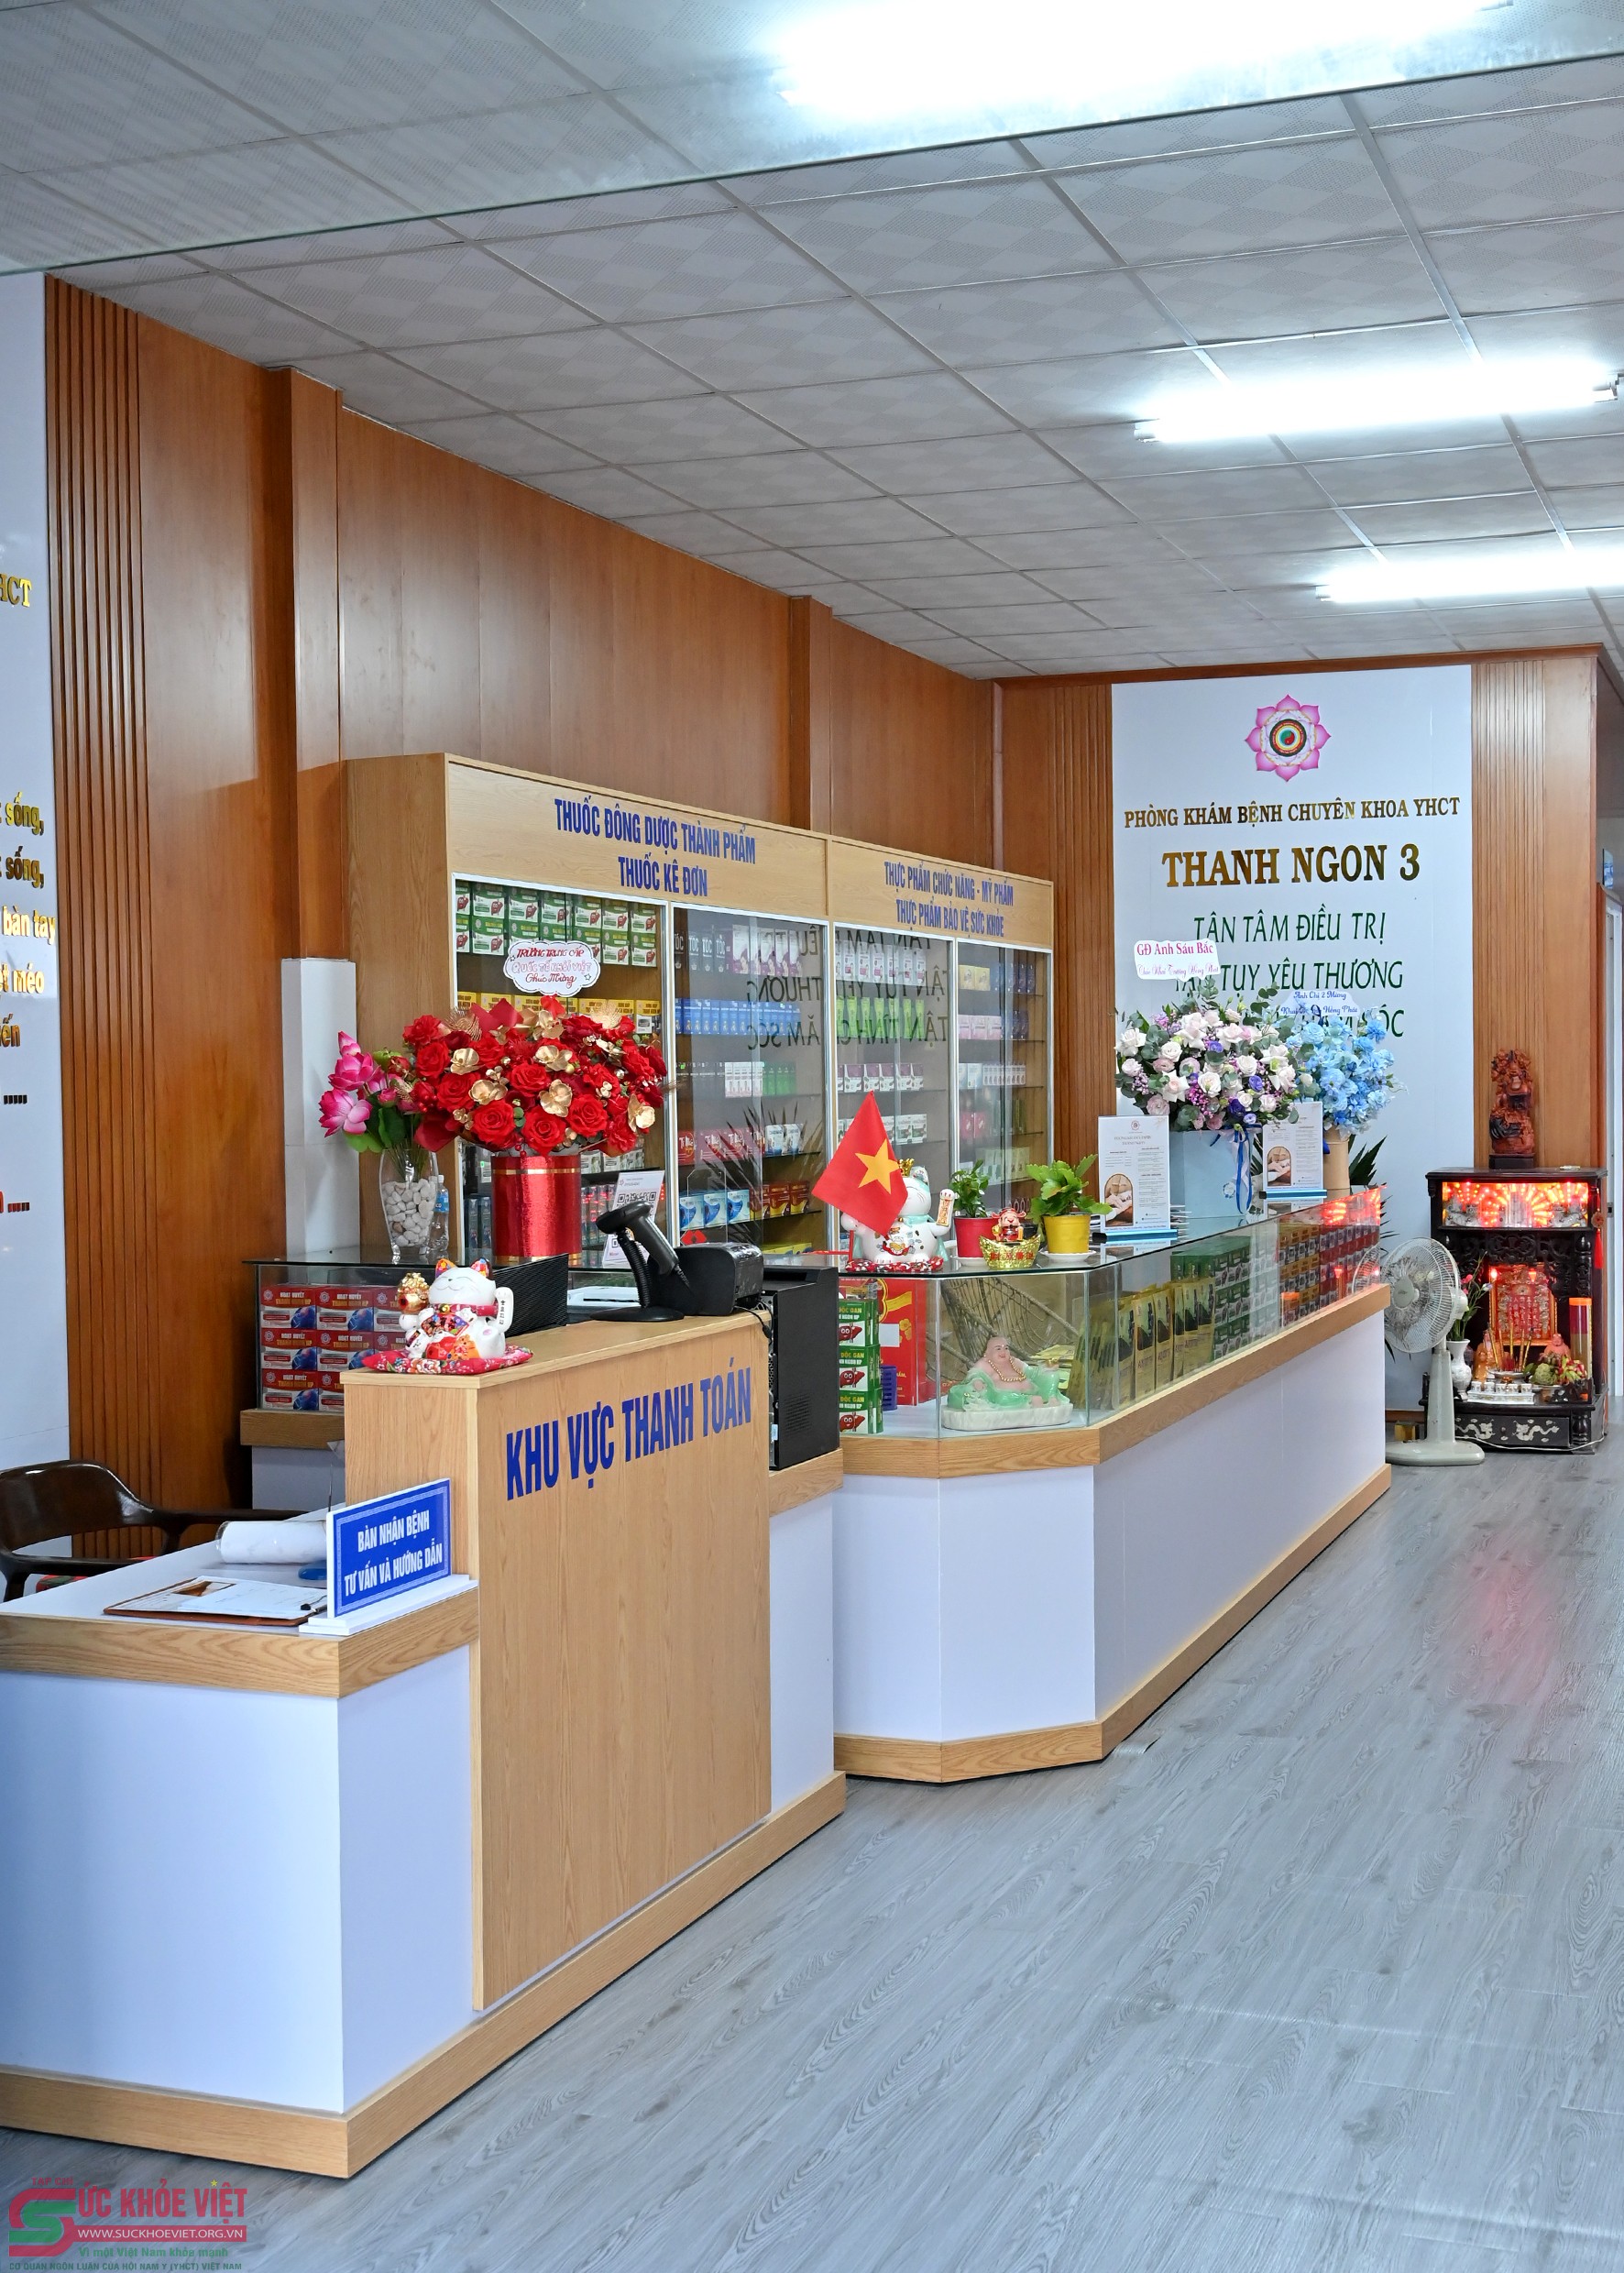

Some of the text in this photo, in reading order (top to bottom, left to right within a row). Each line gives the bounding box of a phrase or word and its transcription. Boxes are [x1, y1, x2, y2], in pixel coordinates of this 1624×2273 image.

[5, 791, 44, 836] sống,
[554, 795, 756, 864] THUỐC ĐÔNG DƯỢC THÀNH PHẨM
[1125, 796, 1460, 828] PHÒNG KHÁM BỆNH CHUYÊN KHOA YHCT
[5, 845, 44, 889] sống,
[618, 852, 708, 896] THUỐC KÊ ĐƠN
[883, 861, 905, 893] THỰC
[907, 861, 931, 893] PHẨM
[933, 869, 953, 896] CHỨC
[955, 873, 975, 900] NĂNG
[982, 877, 993, 903] MỸ
[994, 877, 1014, 906] PHẨM
[1162, 843, 1421, 887] THANH NGON 3
[3, 906, 56, 945] bàn tay
[895, 895, 1004, 939] THỰC PHẨM BẢO VỆ SỨC KHỎE
[1243, 910, 1289, 941] TÂM
[1296, 903, 1340, 940] ĐIỀU
[1352, 912, 1386, 945] TRỊ
[1136, 940, 1213, 955] GĐ Anh Sáu Bắc
[13, 962, 45, 994] méo
[1269, 957, 1304, 990] YÊU
[1314, 958, 1403, 990] THƯƠNG
[507, 1357, 752, 1501] KHU VỰC THANH TOÁN
[357, 1510, 430, 1553] BÀN NHẬN BỆNH
[345, 1538, 443, 1597] TƯ VẤN VÀ HƯỚNG DẪN
